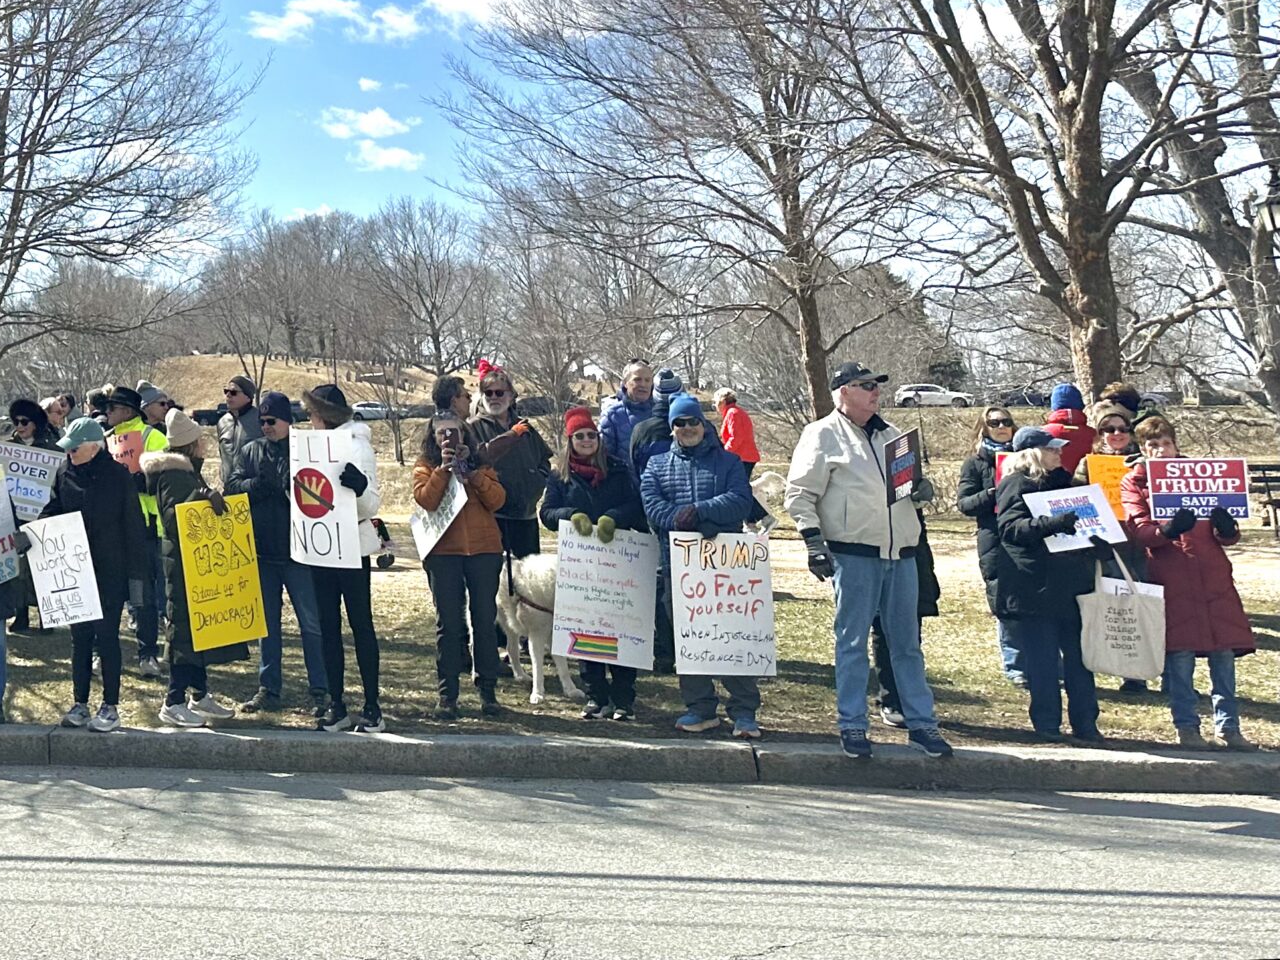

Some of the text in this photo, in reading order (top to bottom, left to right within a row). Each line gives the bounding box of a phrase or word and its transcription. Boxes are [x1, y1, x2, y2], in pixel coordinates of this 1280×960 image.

[8, 461, 48, 480] OVER
[1165, 462, 1228, 477] STOP
[6, 477, 44, 499] Chaos
[894, 480, 913, 501] TRUMP
[1155, 478, 1241, 493] TRUMP
[1047, 499, 1063, 509] THIS
[1063, 498, 1073, 508] IS
[1181, 496, 1219, 506] SAVE
[184, 501, 234, 545] SOS
[1082, 517, 1102, 528] LIKE
[292, 519, 342, 560] NO!
[193, 533, 256, 577] USA!
[54, 570, 78, 590] US
[191, 577, 249, 603] Stand up for
[680, 573, 707, 599] GO
[194, 597, 261, 631] DEMOCRACY!
[1106, 606, 1134, 616] fight
